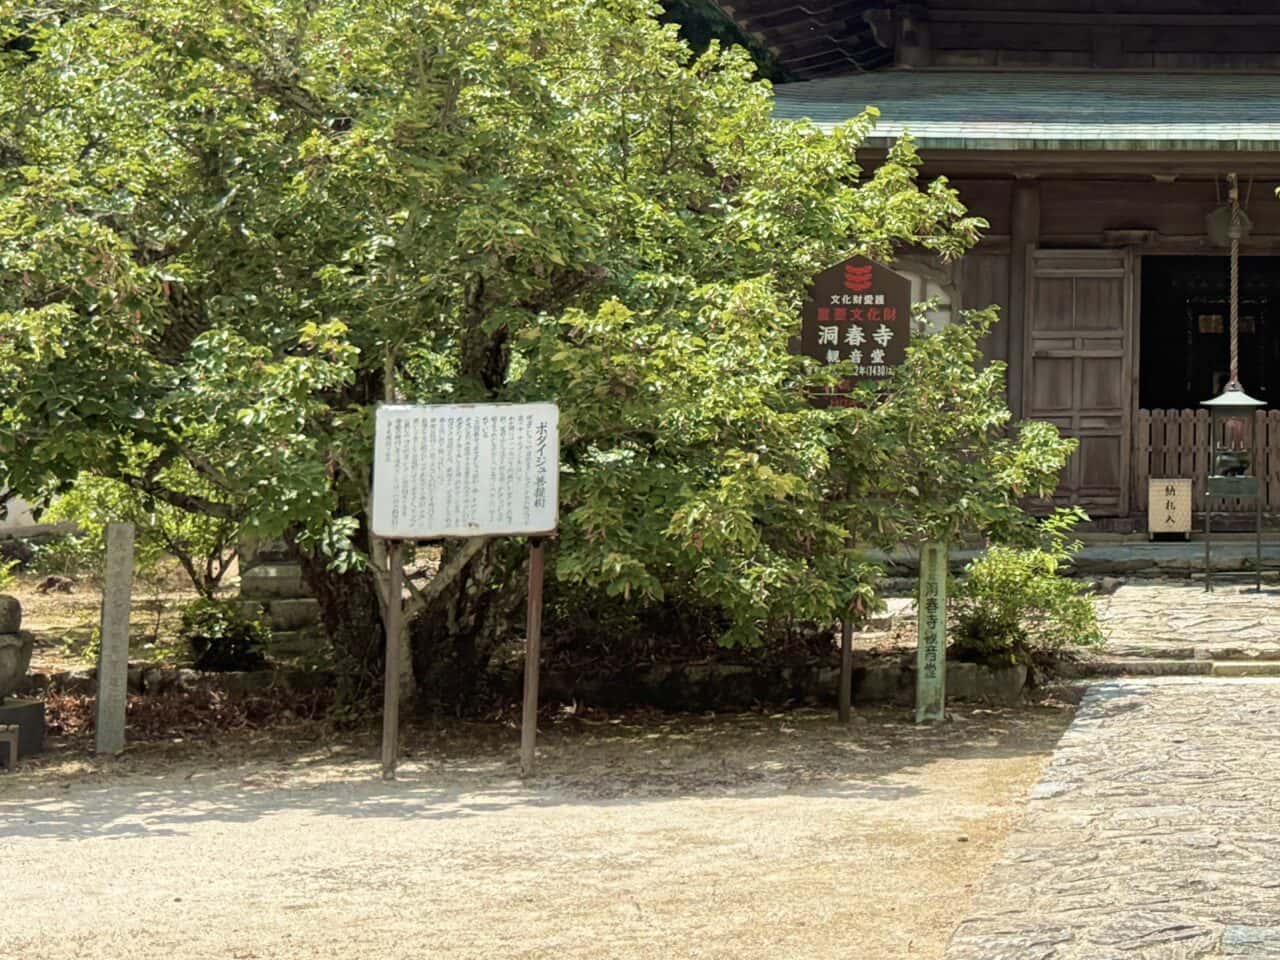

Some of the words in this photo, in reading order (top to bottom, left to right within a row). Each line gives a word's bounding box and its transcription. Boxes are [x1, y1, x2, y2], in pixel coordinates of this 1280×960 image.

[831, 295, 885, 305] 文化財愛護
[818, 324, 894, 348] 洞春寺
[826, 349, 886, 364] 観音堂
